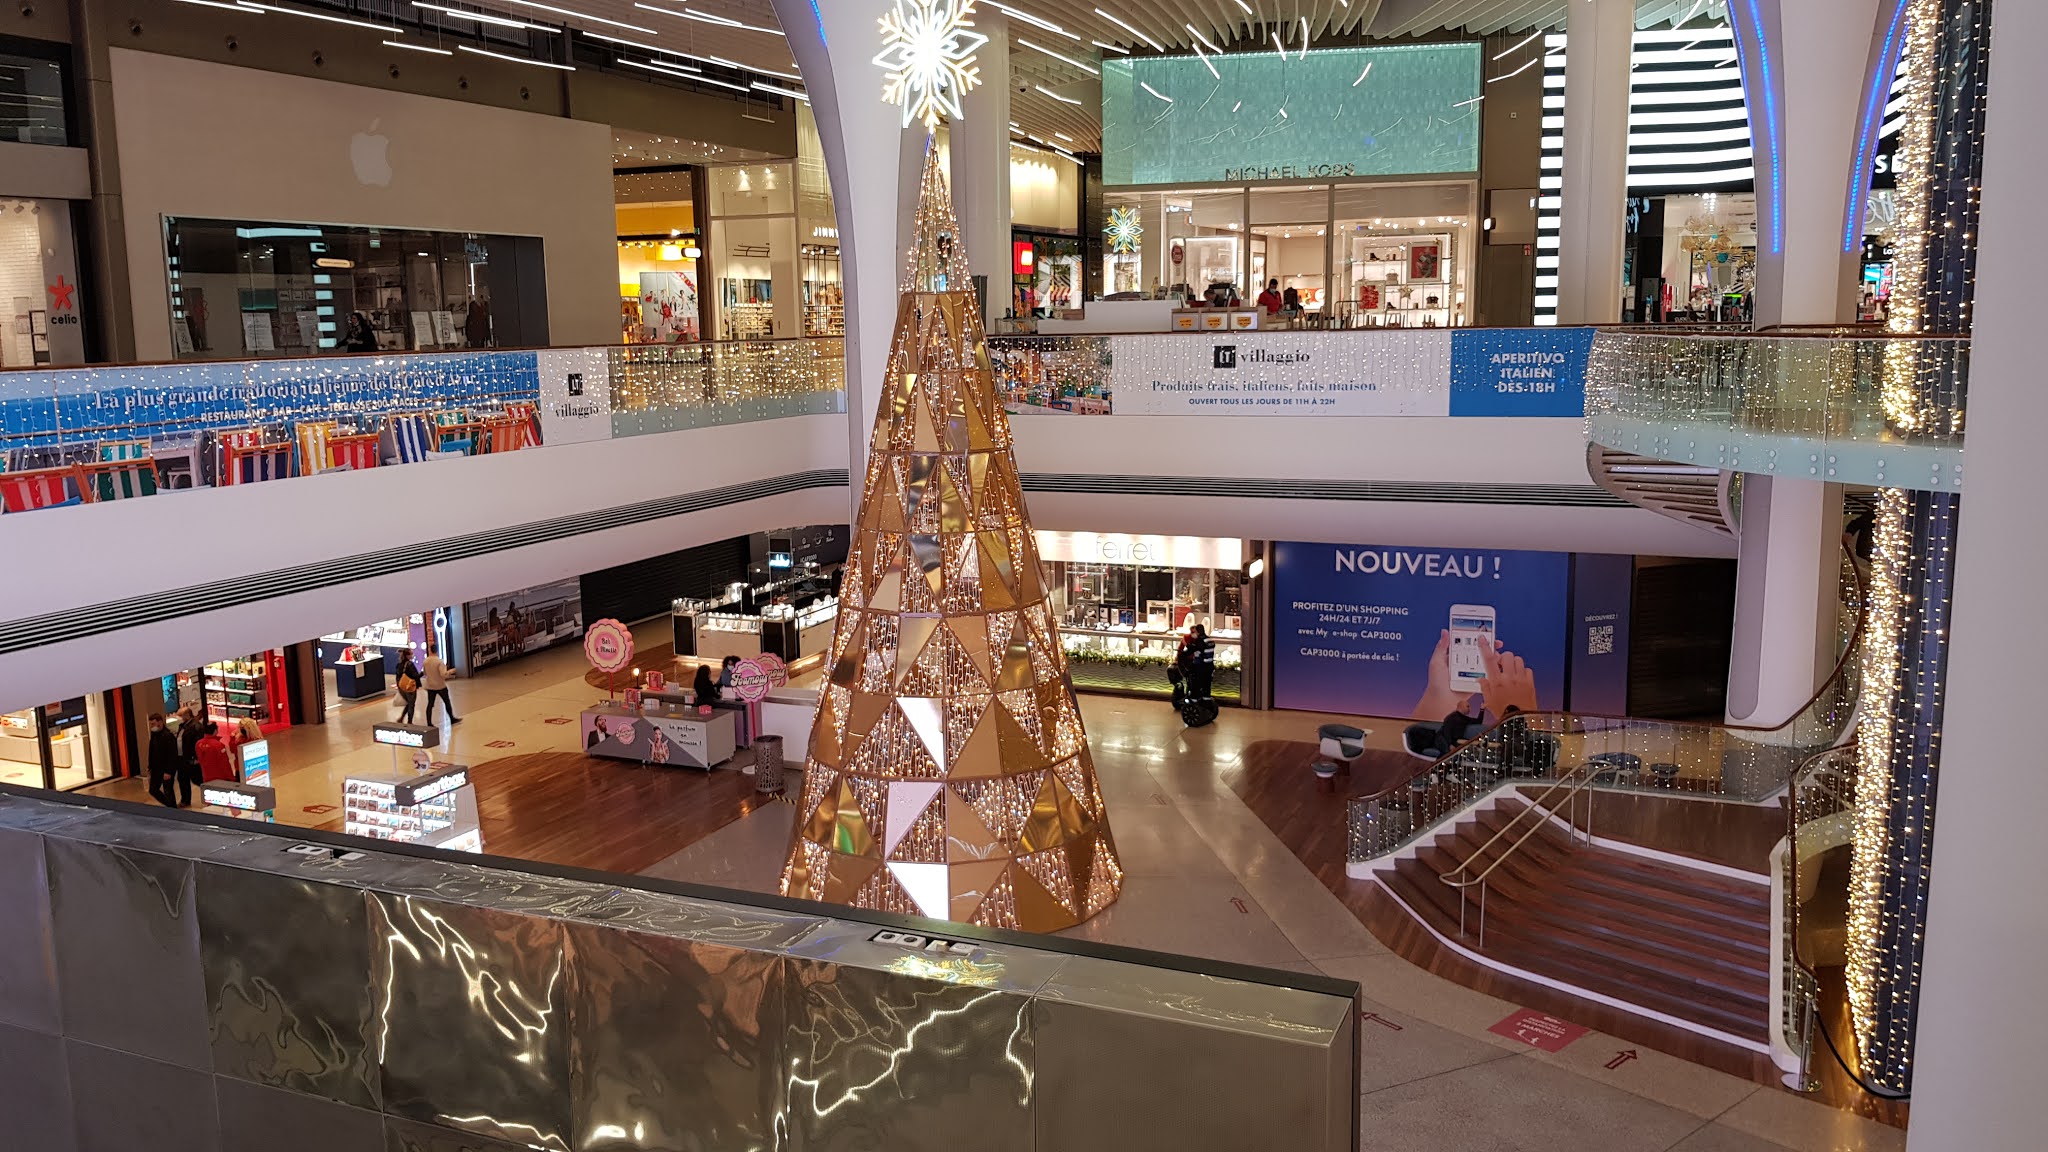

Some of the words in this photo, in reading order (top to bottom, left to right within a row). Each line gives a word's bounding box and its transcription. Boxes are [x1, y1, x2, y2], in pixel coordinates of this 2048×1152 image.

[1225, 166, 1300, 181] MICHAEL
[1308, 162, 1355, 178] KORS
[51, 314, 78, 325] celio
[1240, 350, 1310, 366] villaggio
[1490, 353, 1565, 364] APERITIVO
[1501, 367, 1554, 379] ITALIEN
[1152, 381, 1203, 393] Produits
[1297, 381, 1325, 392] faits
[1328, 382, 1377, 392] maison
[1529, 382, 1555, 393] 18H
[125, 390, 163, 412] plus
[168, 385, 229, 409] grande
[232, 380, 299, 402] trattoria
[200, 408, 265, 423] RESTAURANT
[273, 406, 293, 417] BAR
[555, 403, 599, 419] villaggio
[1335, 550, 1484, 579] NOUVEAU
[1493, 557, 1501, 579] !
[1292, 602, 1334, 611] PROFITEZ
[1336, 604, 1358, 613] D'UN
[1360, 605, 1409, 616] SHOPPING
[1319, 614, 1350, 623] 24H/24
[1351, 616, 1362, 624] ET
[1363, 617, 1381, 625] 7J/7
[1316, 628, 1328, 638] My
[1332, 629, 1357, 639] e-shop
[1360, 630, 1402, 640] CAP3000
[1300, 647, 1340, 657] CAP3000
[1371, 652, 1380, 660] de
[1381, 652, 1395, 661] clic
